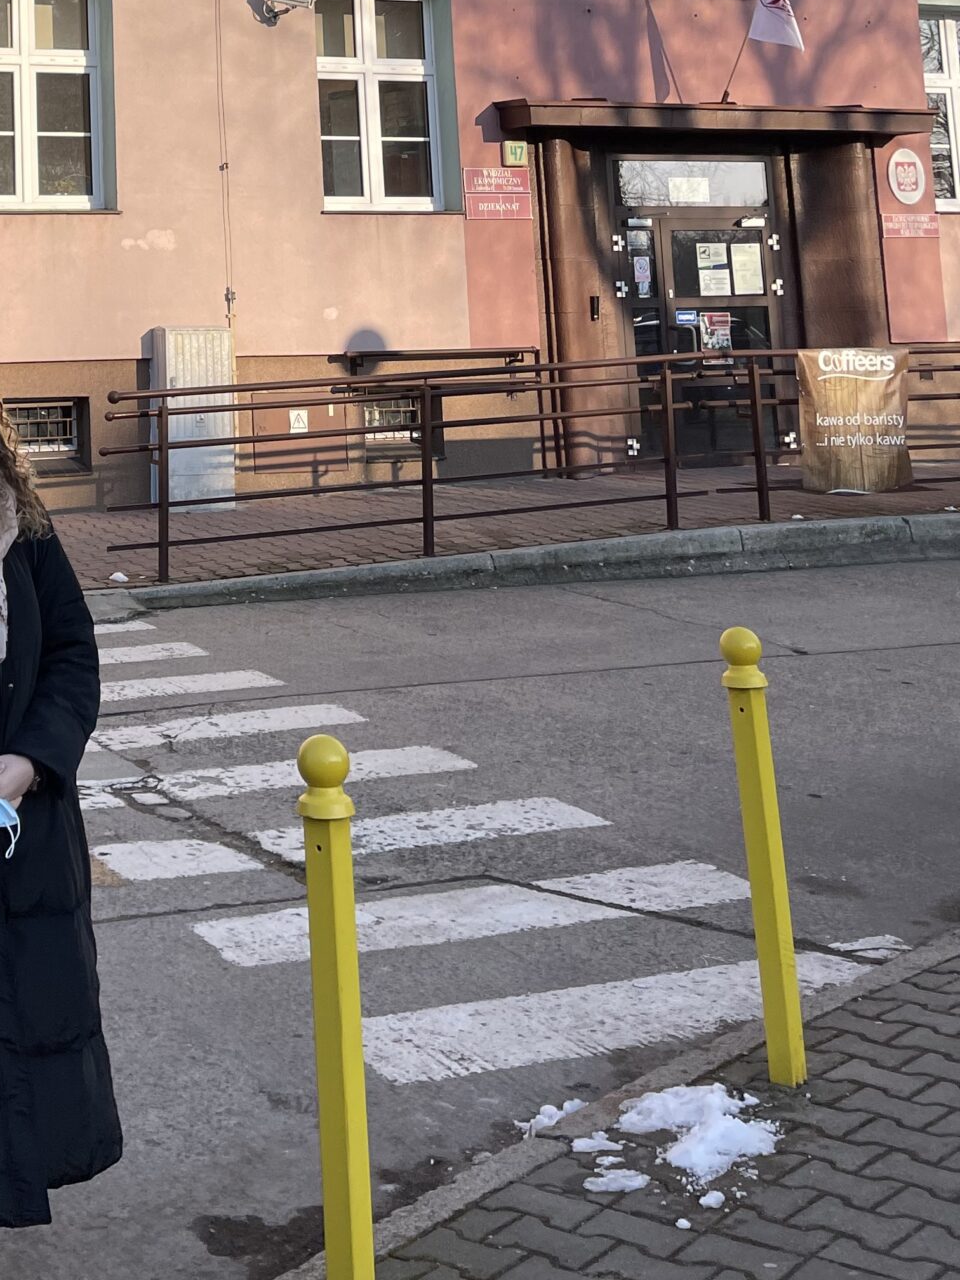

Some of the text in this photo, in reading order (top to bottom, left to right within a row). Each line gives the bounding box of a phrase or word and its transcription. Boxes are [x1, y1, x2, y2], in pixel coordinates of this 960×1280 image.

[510, 145, 524, 162] 47
[473, 177, 521, 185] EKONOMICZNY
[818, 351, 895, 371] Coffeers
[816, 412, 904, 428] kawa od baristy
[830, 434, 845, 446] nie
[847, 432, 874, 448] tylko
